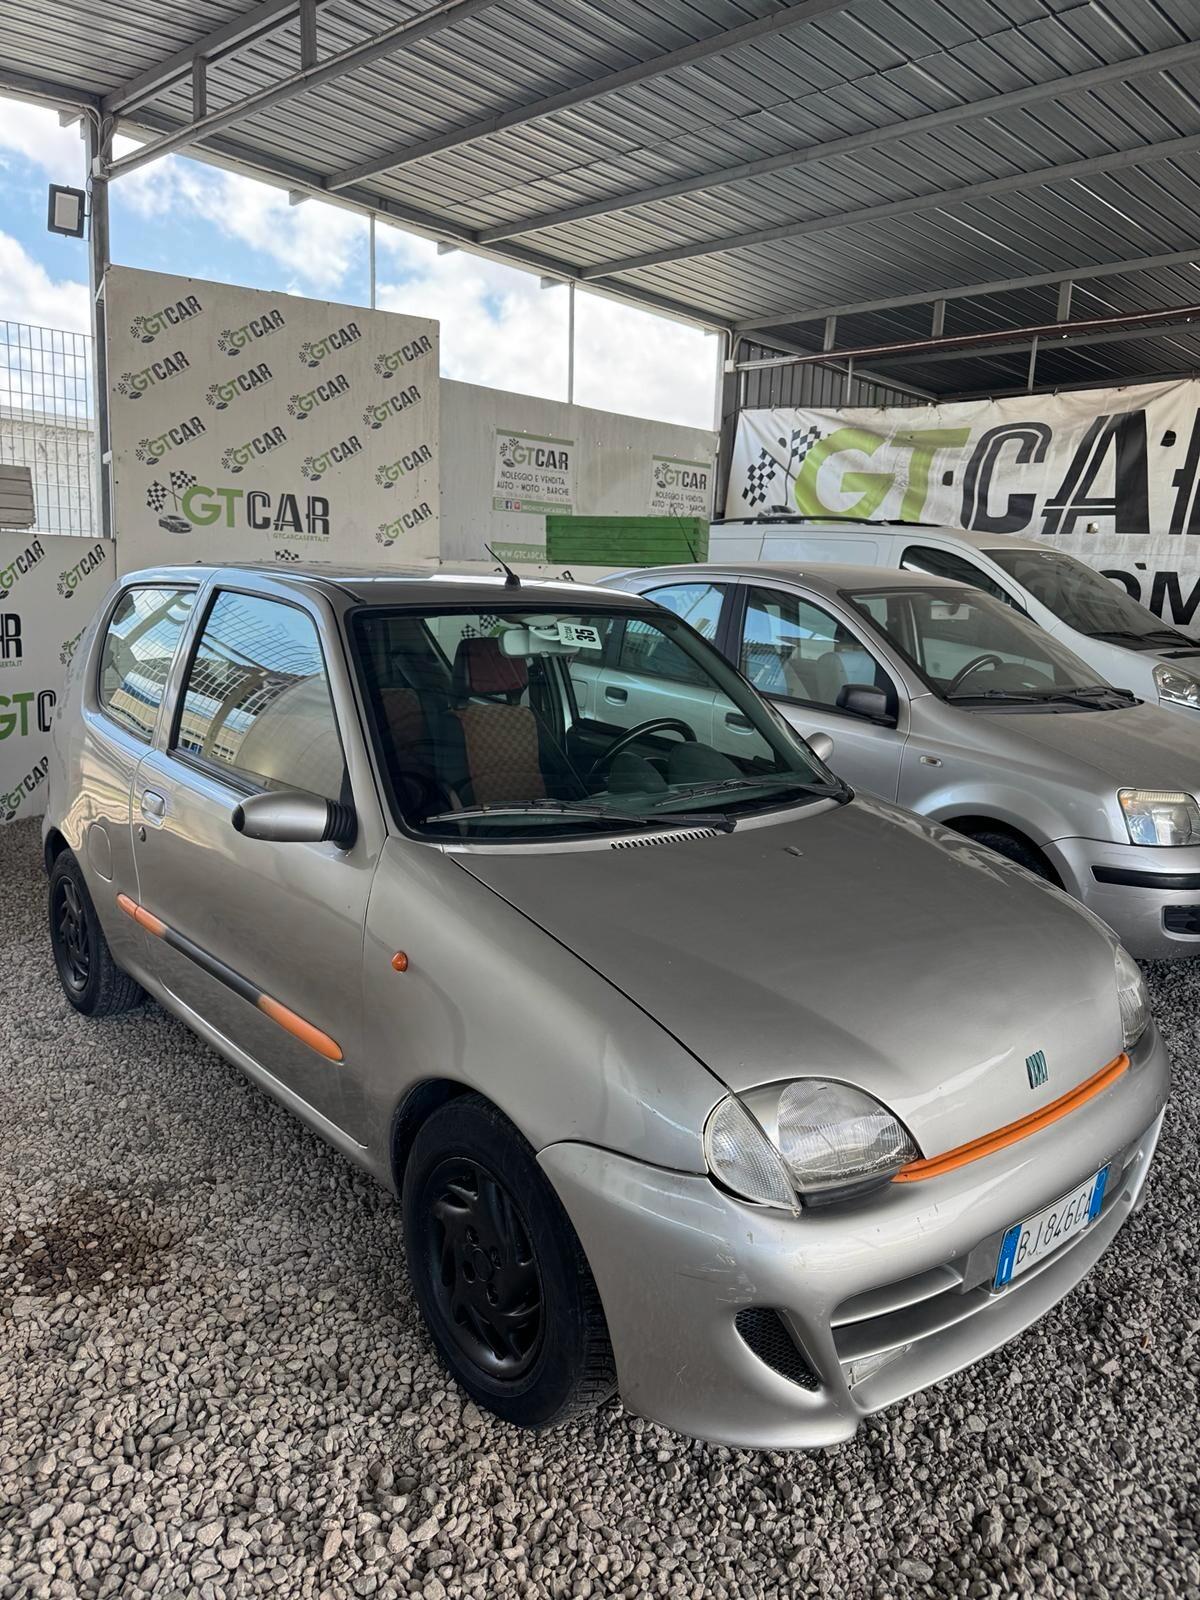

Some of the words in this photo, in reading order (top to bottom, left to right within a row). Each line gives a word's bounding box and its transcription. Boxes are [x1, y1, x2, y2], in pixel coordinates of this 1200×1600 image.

[142, 295, 202, 336] GTCAR
[229, 309, 285, 349] GTCAR
[311, 322, 362, 361] GTCAR
[384, 335, 433, 372] GTCAR
[130, 351, 190, 392] GTCAR
[217, 363, 273, 402] GTCAR
[298, 374, 350, 412] GTCAR
[373, 385, 422, 422] GTCAR
[148, 416, 206, 457] GTCAR
[232, 426, 287, 467] GTCAR
[311, 435, 363, 474] GTCAR
[384, 444, 433, 482] GTCAR
[512, 445, 569, 471] GTCAR
[497, 481, 514, 489] AUTO
[664, 469, 707, 490] GTCAR
[182, 486, 330, 535] GTCAR
[384, 502, 433, 540] GTCAR
[66, 544, 106, 589] GTCAR
[575, 628, 596, 641] 35
